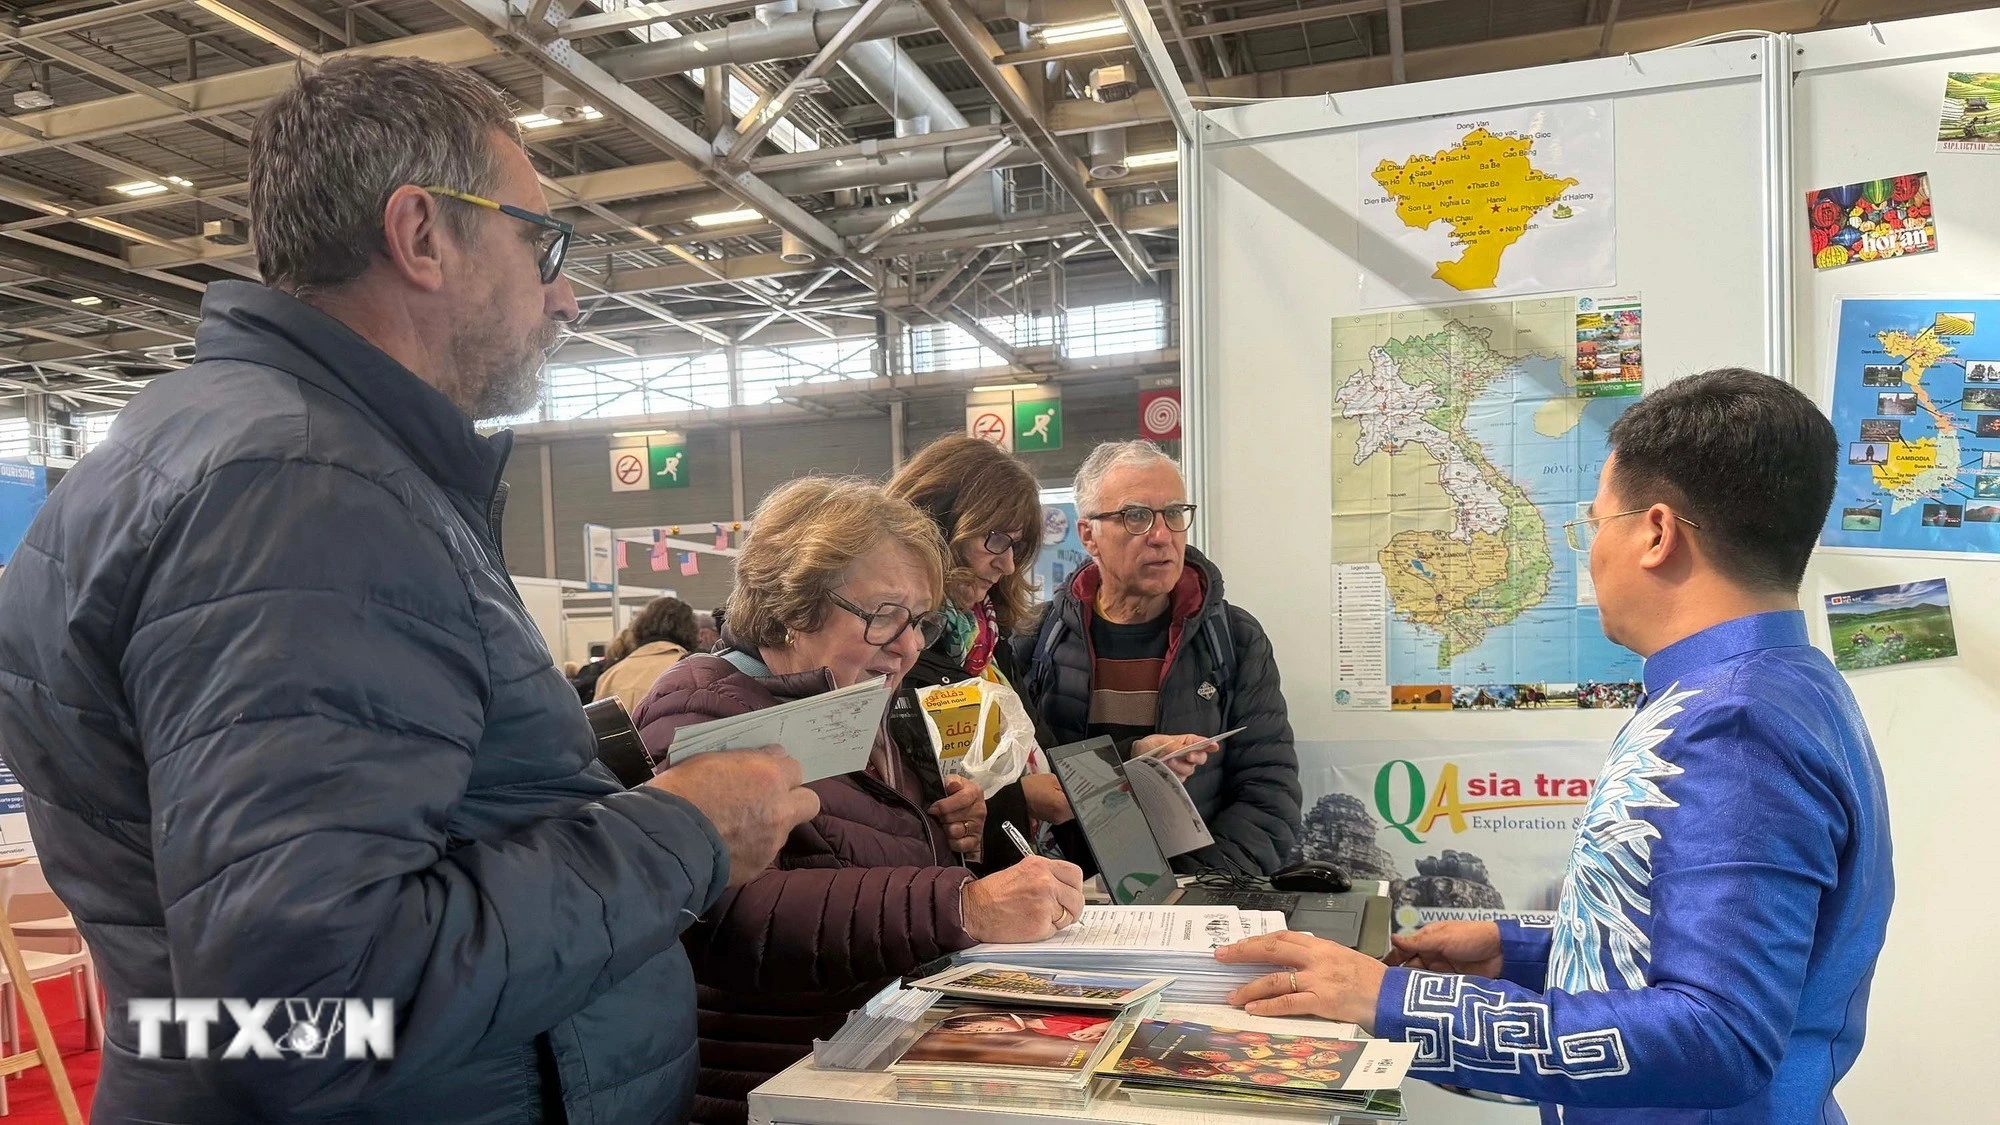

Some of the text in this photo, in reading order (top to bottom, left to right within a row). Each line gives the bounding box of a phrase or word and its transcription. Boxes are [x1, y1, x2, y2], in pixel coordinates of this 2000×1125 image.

[1563, 192, 1594, 201] d'Halong
[1450, 231, 1477, 239] Pagode
[1450, 239, 1478, 247] parfums
[1424, 428, 1438, 436] LAOS
[926, 700, 950, 708] Deglet
[1472, 815, 1566, 832] Exploration
